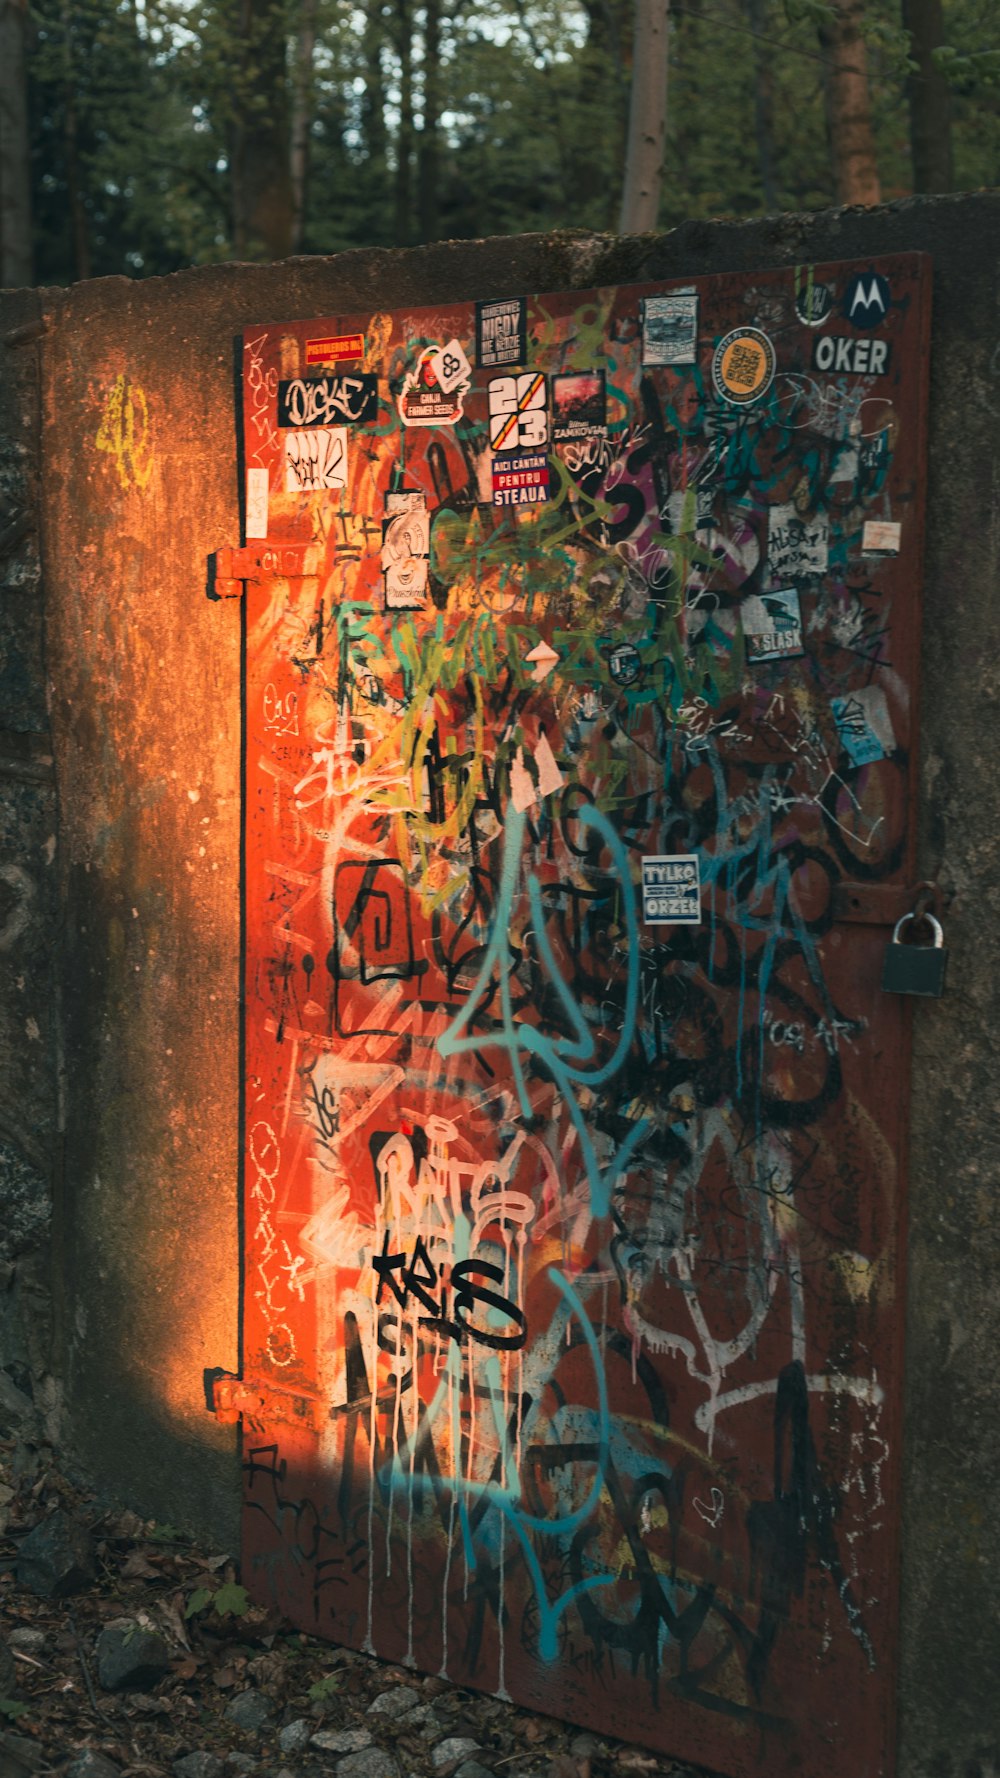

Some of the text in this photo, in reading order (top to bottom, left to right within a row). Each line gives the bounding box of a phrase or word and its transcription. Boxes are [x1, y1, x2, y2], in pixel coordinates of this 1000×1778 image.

[481, 313, 520, 340] NIGDY
[306, 341, 349, 355] PISTOLEROS
[815, 336, 888, 374] OKER
[419, 393, 442, 404] GANJA
[408, 404, 454, 416] FARMER SEEDS
[494, 460, 511, 472] AICI
[498, 472, 541, 487] PENTRU
[494, 486, 547, 506] STEAUA
[644, 864, 695, 884] TYLKO
